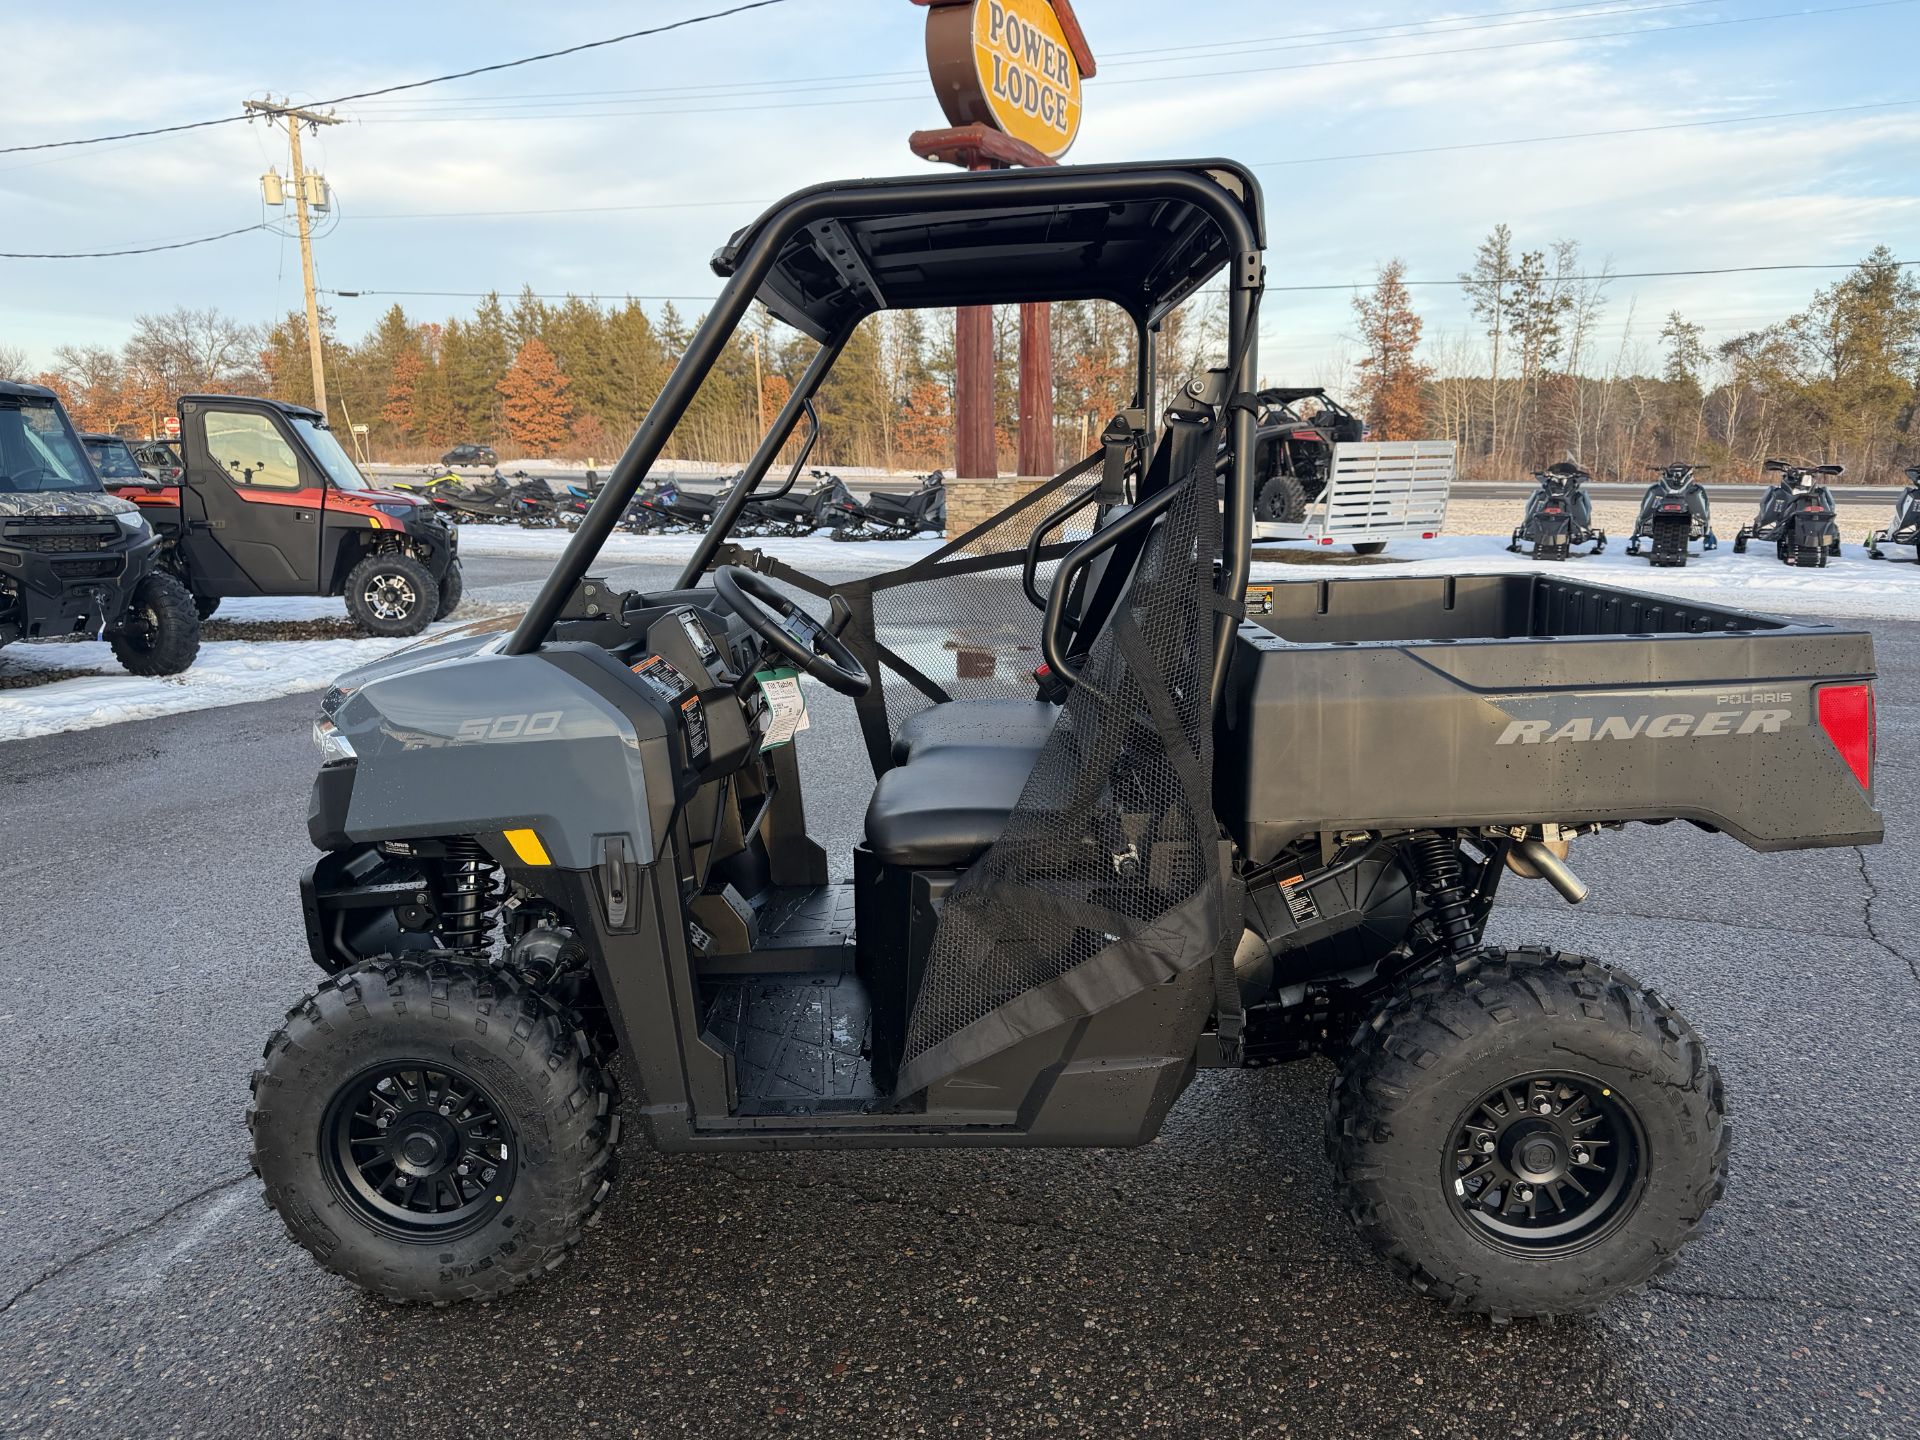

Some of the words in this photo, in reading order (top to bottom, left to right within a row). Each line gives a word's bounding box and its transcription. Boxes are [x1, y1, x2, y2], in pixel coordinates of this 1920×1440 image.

[989, 1, 1070, 90] POWER
[992, 54, 1068, 131] LODGE
[1716, 691, 1793, 705] POLARIS
[457, 711, 564, 742] 500
[1494, 708, 1793, 746] RANGER
